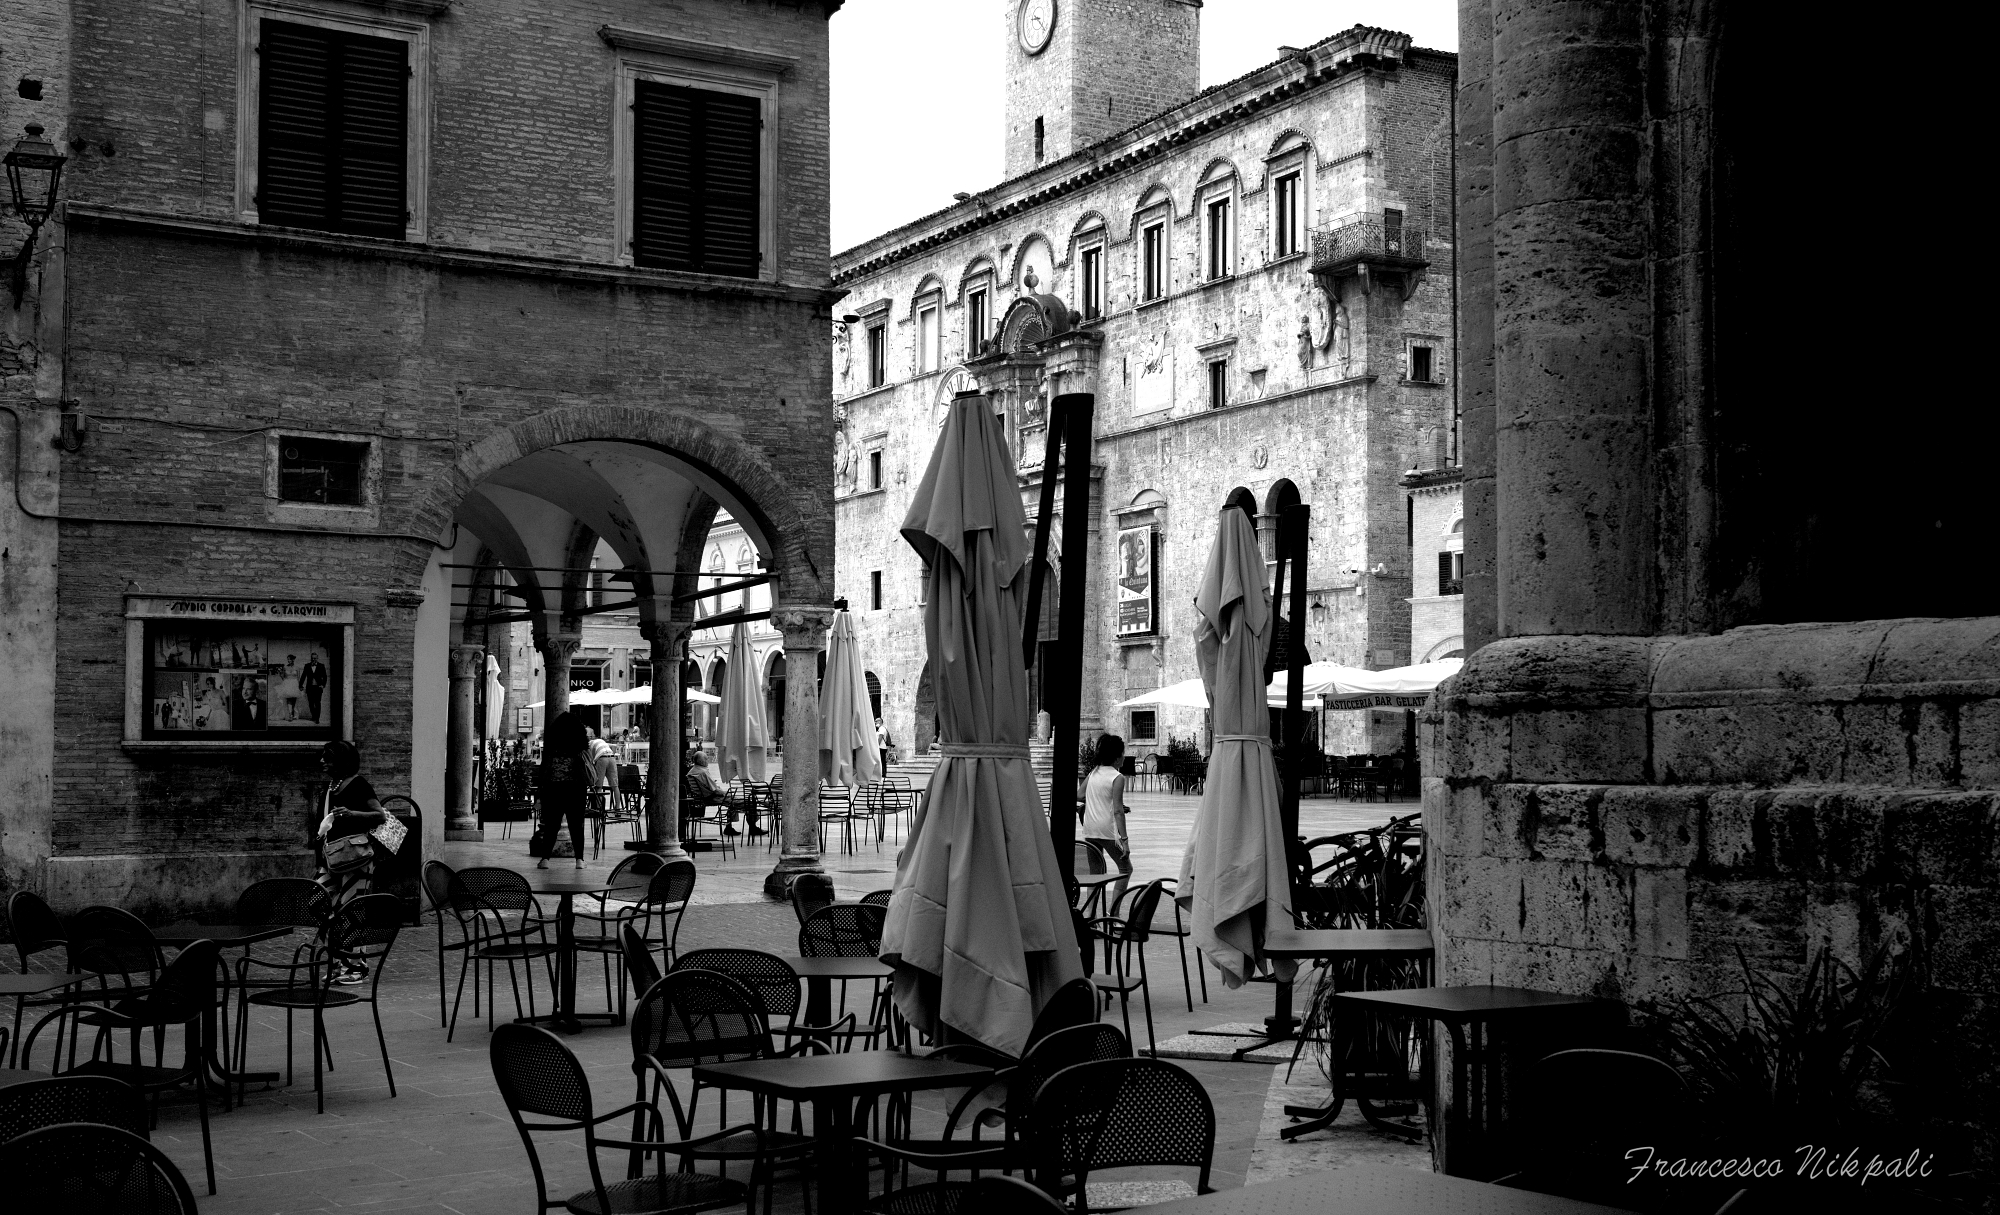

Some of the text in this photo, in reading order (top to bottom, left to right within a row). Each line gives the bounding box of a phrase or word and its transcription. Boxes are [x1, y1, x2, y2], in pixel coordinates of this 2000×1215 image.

[1326, 695, 1429, 710] PASTICCERIA BAR GELATE
